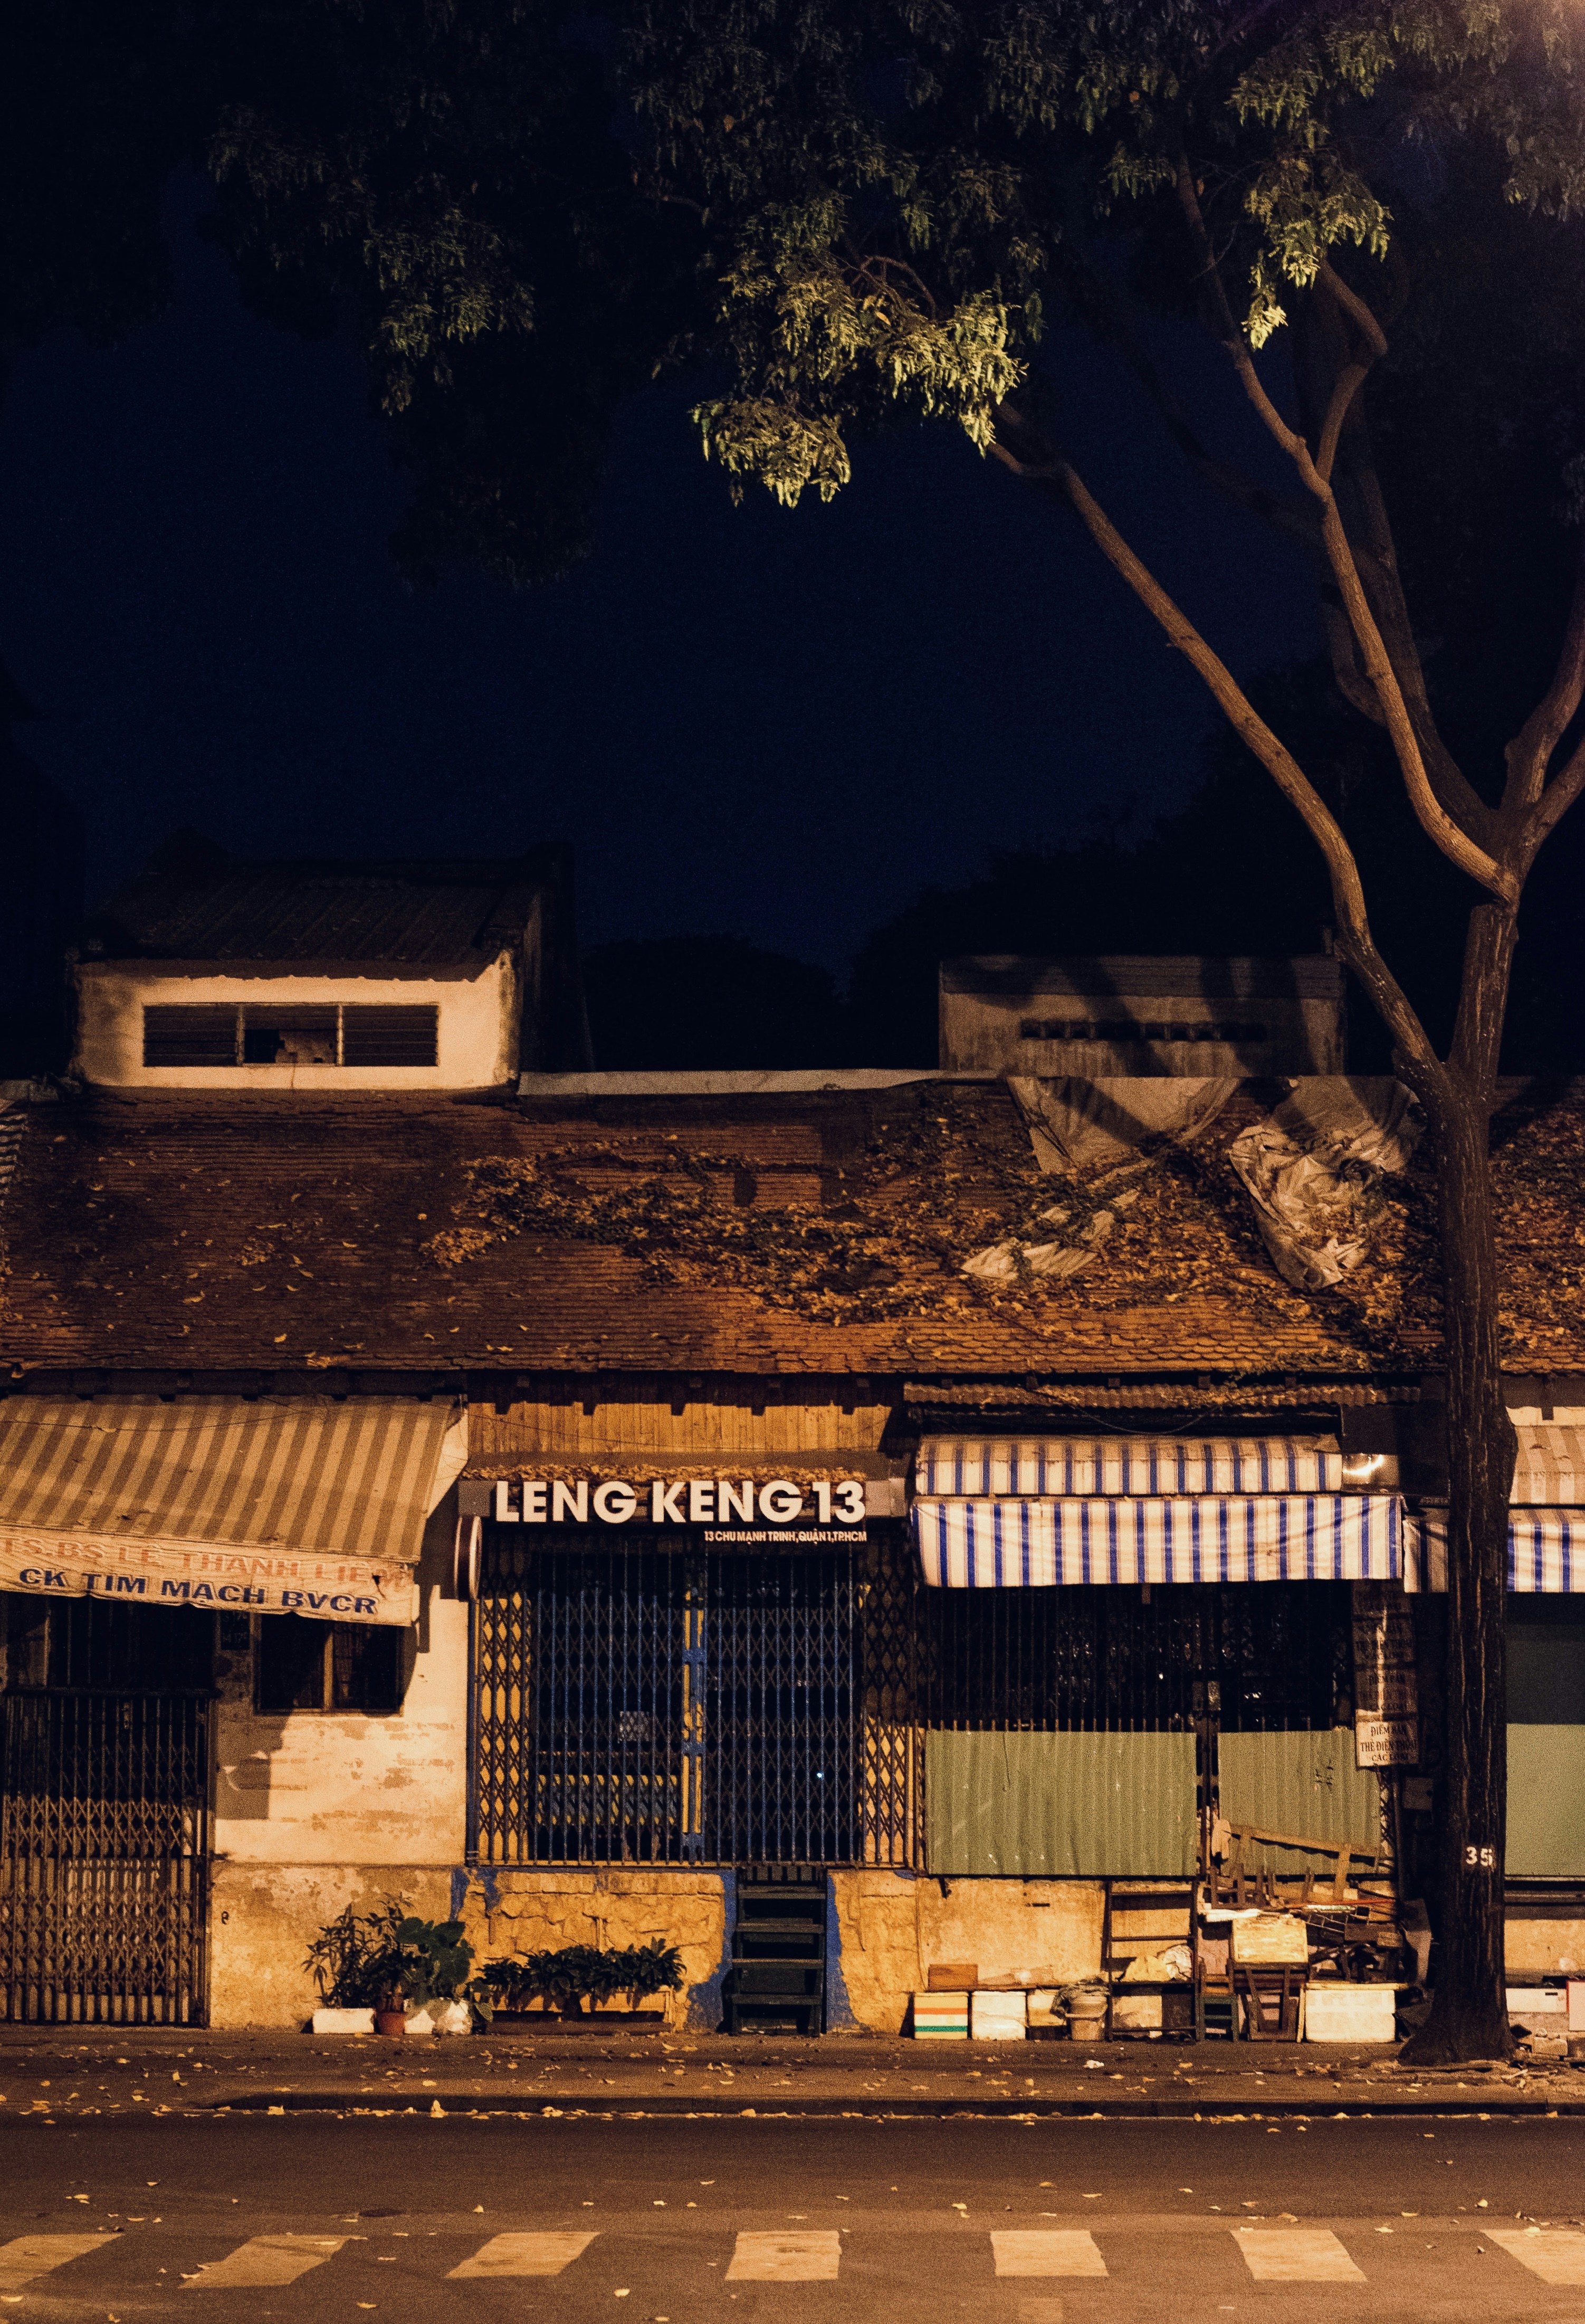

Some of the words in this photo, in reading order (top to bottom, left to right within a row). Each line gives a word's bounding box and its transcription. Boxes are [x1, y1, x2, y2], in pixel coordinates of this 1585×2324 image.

[495, 1480, 637, 1523] LENG
[652, 1480, 803, 1523] KENG
[813, 1480, 866, 1523] 13
[704, 1531, 714, 1541] 13
[715, 1531, 736, 1541] CHU
[183, 1552, 299, 1577] THANH
[20, 1568, 67, 1587] CK
[81, 1573, 146, 1594] TIM
[282, 1590, 377, 1614] BVCR
[1465, 1845, 1493, 1868] 35
